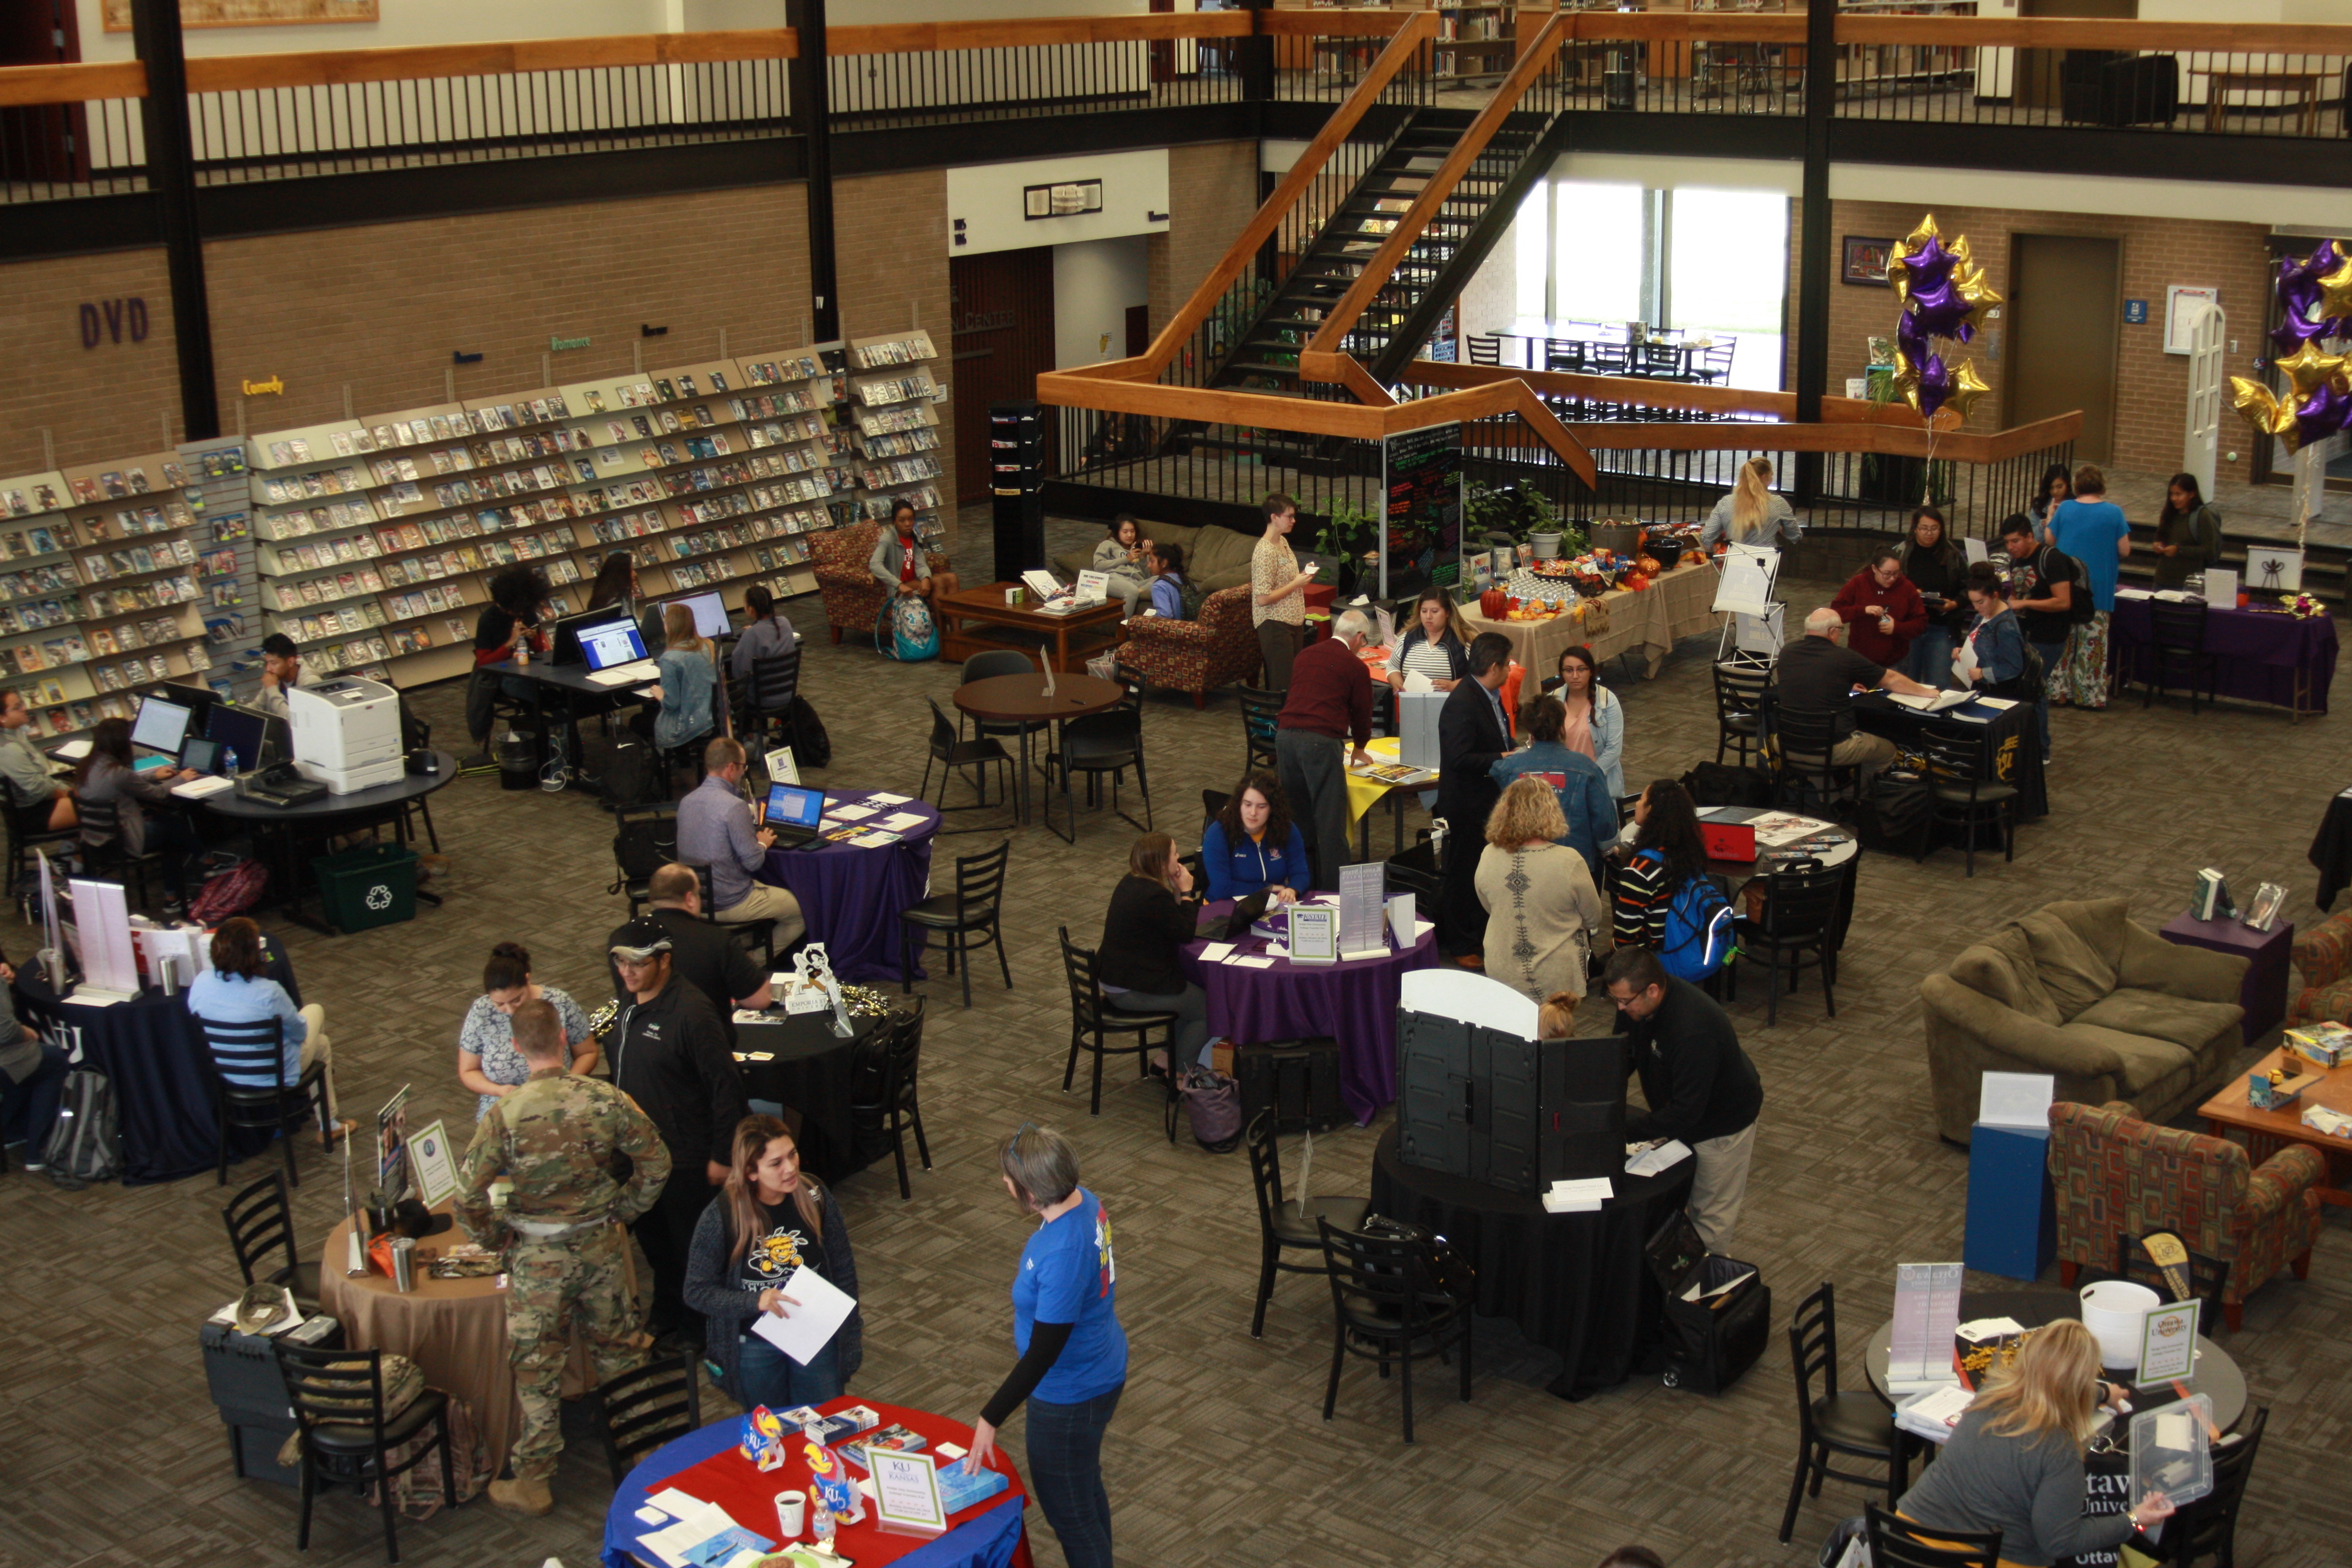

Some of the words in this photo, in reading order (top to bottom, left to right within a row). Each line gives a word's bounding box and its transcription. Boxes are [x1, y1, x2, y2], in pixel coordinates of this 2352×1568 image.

[80, 298, 149, 348] DVD
[552, 337, 591, 351] Romance
[243, 375, 284, 395] Comedy
[792, 999, 818, 1008] EMPORIA
[749, 1433, 760, 1449] KU
[893, 1461, 911, 1472] KU
[889, 1473, 919, 1483] KANSAS
[2086, 1472, 2131, 1494] taw
[825, 1485, 839, 1501] KU
